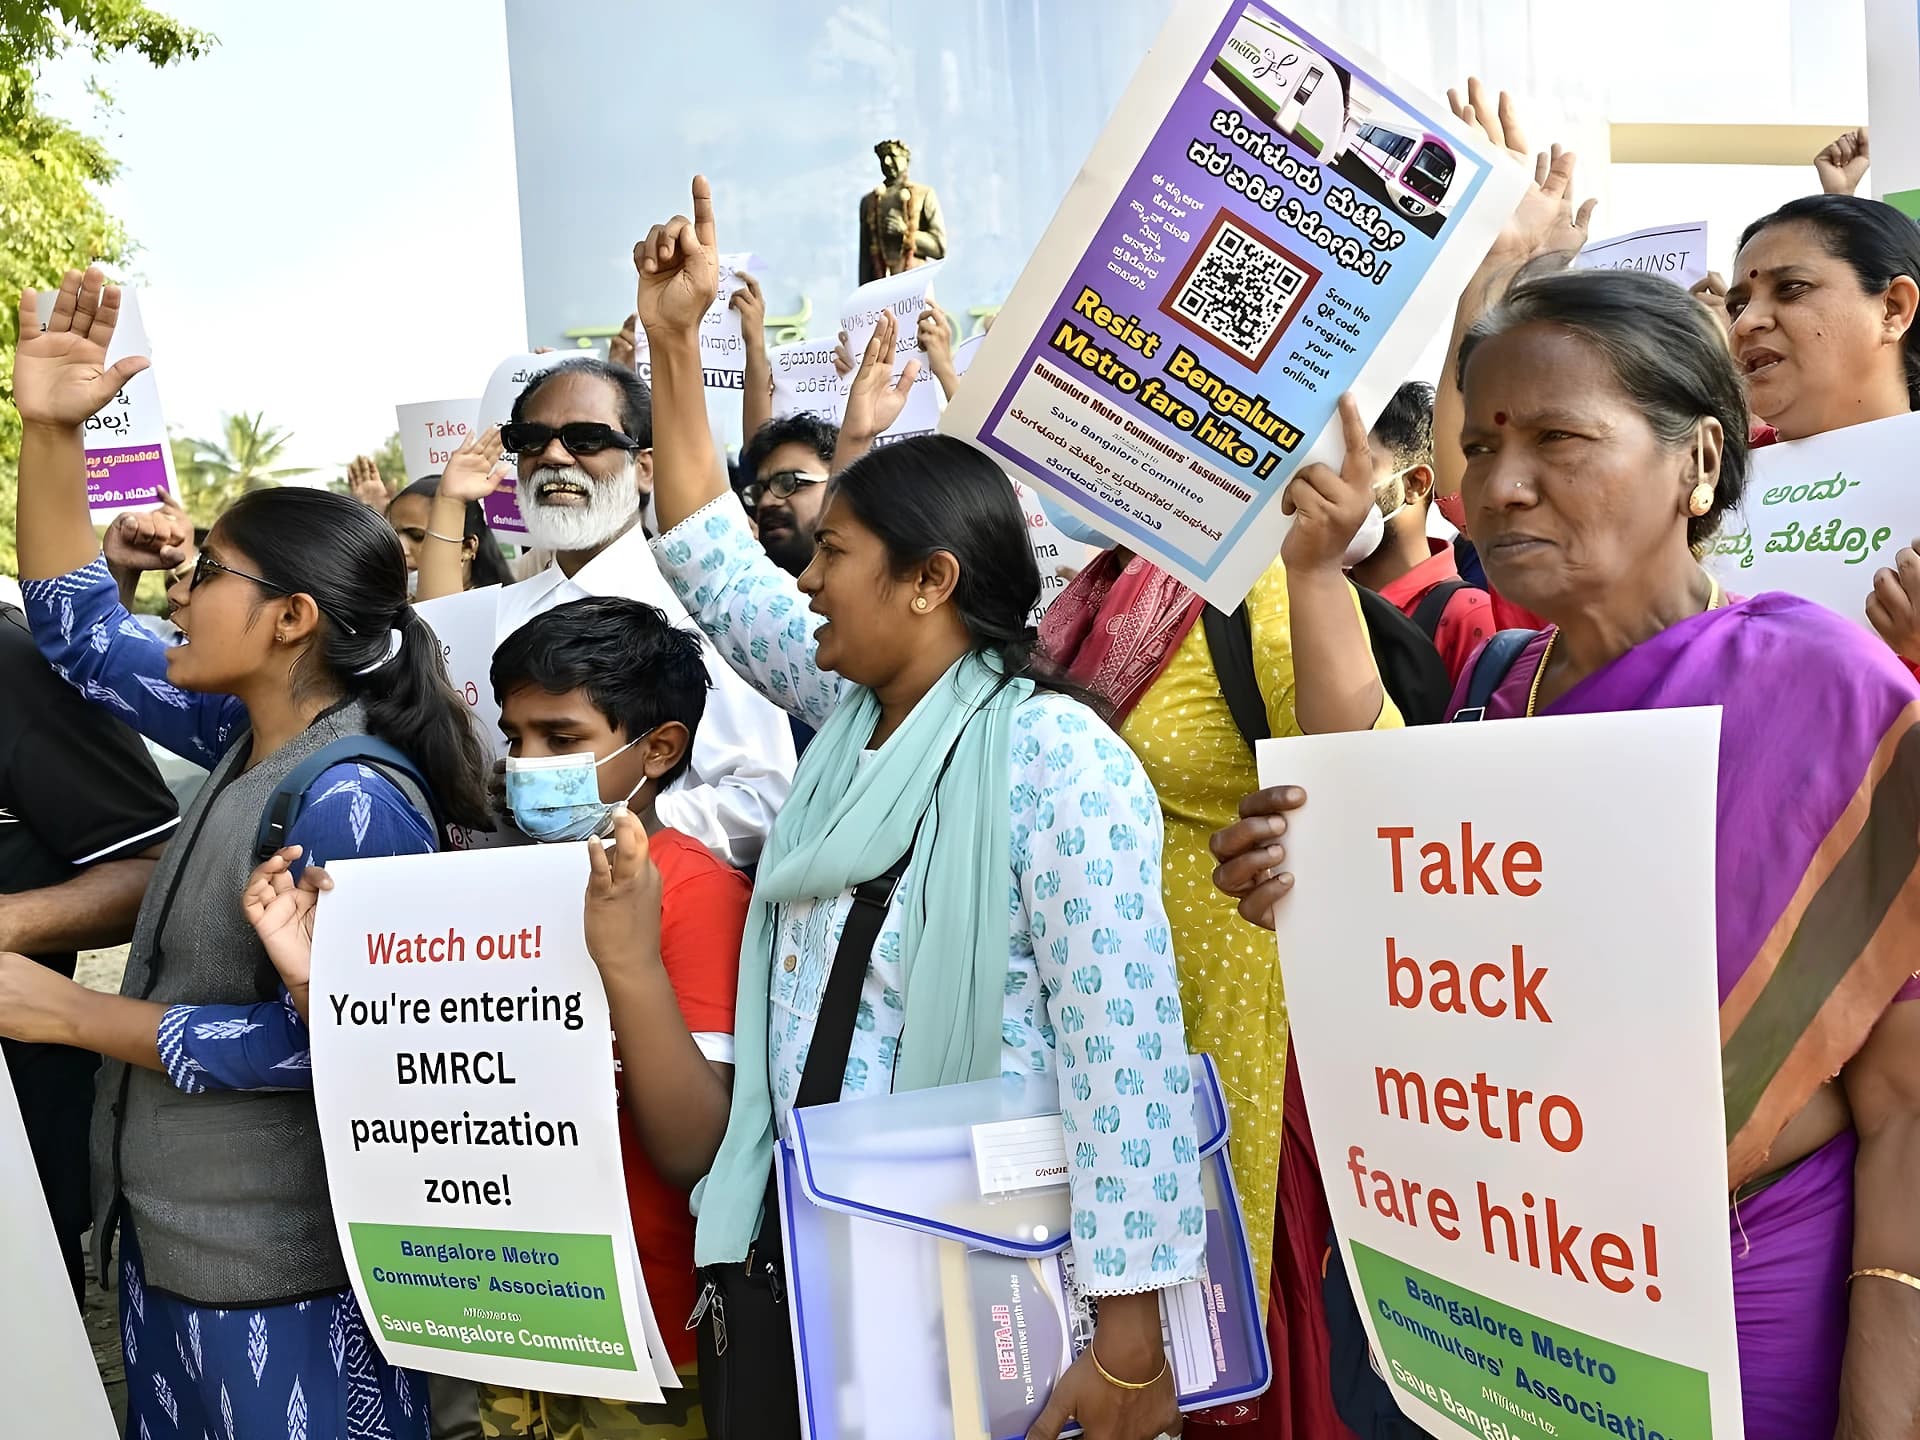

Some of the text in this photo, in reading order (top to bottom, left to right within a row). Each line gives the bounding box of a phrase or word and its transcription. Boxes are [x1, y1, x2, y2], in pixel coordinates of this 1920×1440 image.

[1187, 138, 1232, 176] ದರ
[1224, 164, 1283, 212] ಏರಿಕೆ
[1211, 109, 1405, 251] ಬೆಂಗಳೂರು ಮೆಟ್ರೋ
[1317, 303, 1360, 336] QR code
[1325, 287, 1370, 322] Scan the
[1301, 315, 1358, 354] to register
[1304, 340, 1333, 359] your
[1073, 286, 1302, 451] Resist Bengaluru
[1282, 366, 1317, 393] online.
[1289, 351, 1330, 379] protest
[1051, 322, 1139, 392] Metro
[1139, 379, 1197, 429] fare
[1194, 414, 1256, 468] hike
[425, 421, 467, 438] Take
[1034, 362, 1089, 405] Bangalore
[1090, 398, 1123, 427] Metro
[1189, 459, 1252, 503] Association
[429, 448, 450, 464] ba
[1050, 406, 1078, 428] Save
[1080, 424, 1140, 465] Bangalore
[1141, 462, 1204, 504] Committee
[1764, 518, 1891, 564] ಮೆಟ್ರೋ
[1377, 821, 1544, 898] Take
[366, 925, 542, 966] Watch out!
[1384, 937, 1553, 1024] back
[329, 986, 584, 1031] You're entering
[397, 1051, 516, 1086] BMRCL
[1374, 1064, 1584, 1153] metro
[351, 1111, 578, 1153] pauperization
[423, 1174, 512, 1206] zone!
[1347, 1145, 1662, 1302] fare hike!
[400, 1240, 559, 1266] Bangalore Metro
[372, 1267, 606, 1300] Commuters' Association
[381, 1314, 625, 1356] Save Bangalore Committee
[1377, 1298, 1504, 1377] Commuters'
[1404, 1276, 1617, 1385] Bangalore Metro
[1391, 1358, 1438, 1403] Save
